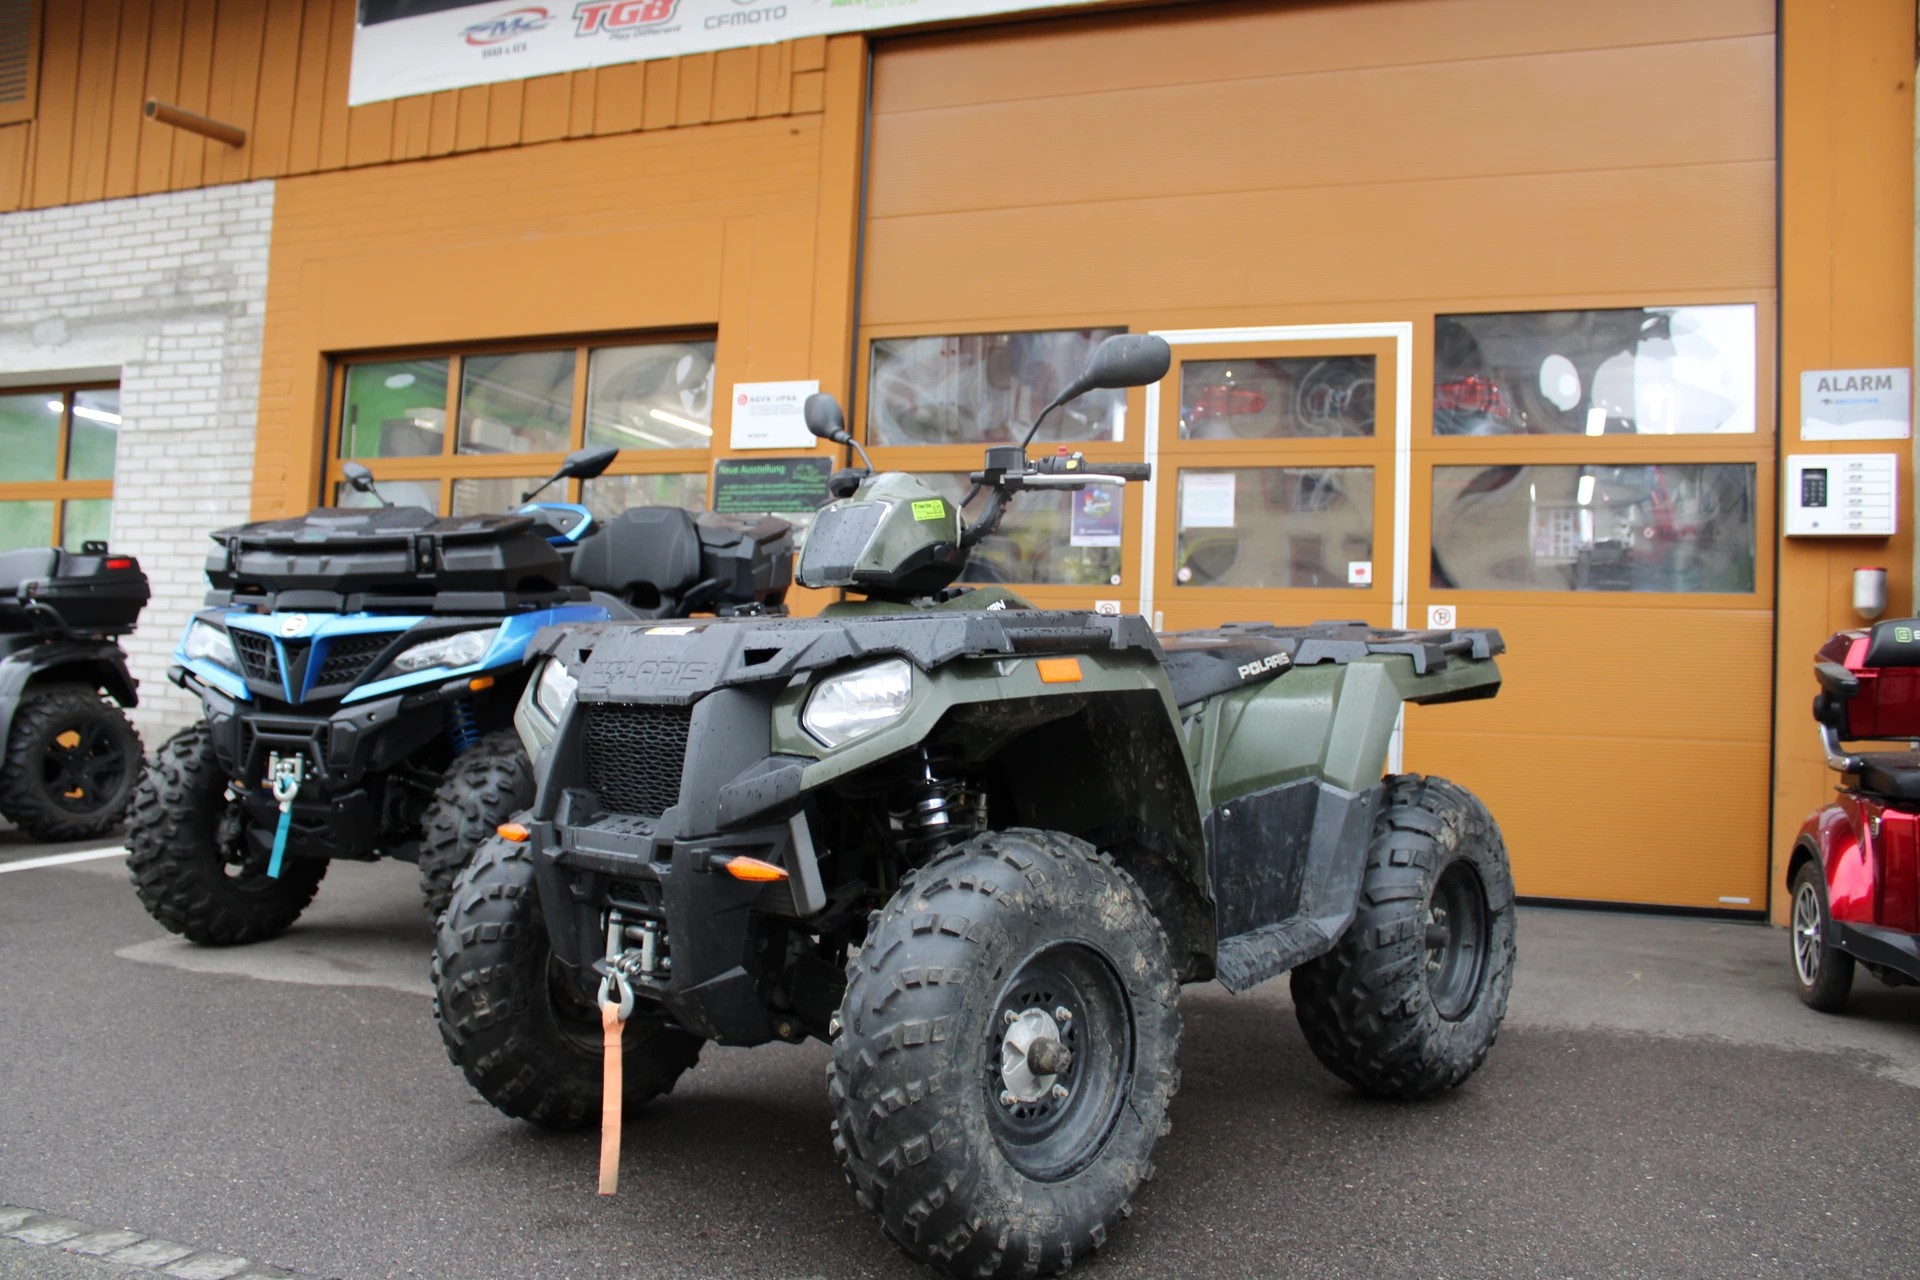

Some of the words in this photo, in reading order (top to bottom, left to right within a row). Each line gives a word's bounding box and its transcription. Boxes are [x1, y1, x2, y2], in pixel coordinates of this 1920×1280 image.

[575, 0, 677, 35] TGB
[703, 5, 787, 29] CFMOTO
[1817, 375, 1893, 392] ALARM
[718, 465, 739, 475] Neue
[740, 463, 786, 476] Ausstellung
[593, 660, 708, 685] POLARIS
[1237, 651, 1290, 679] POLARIS
